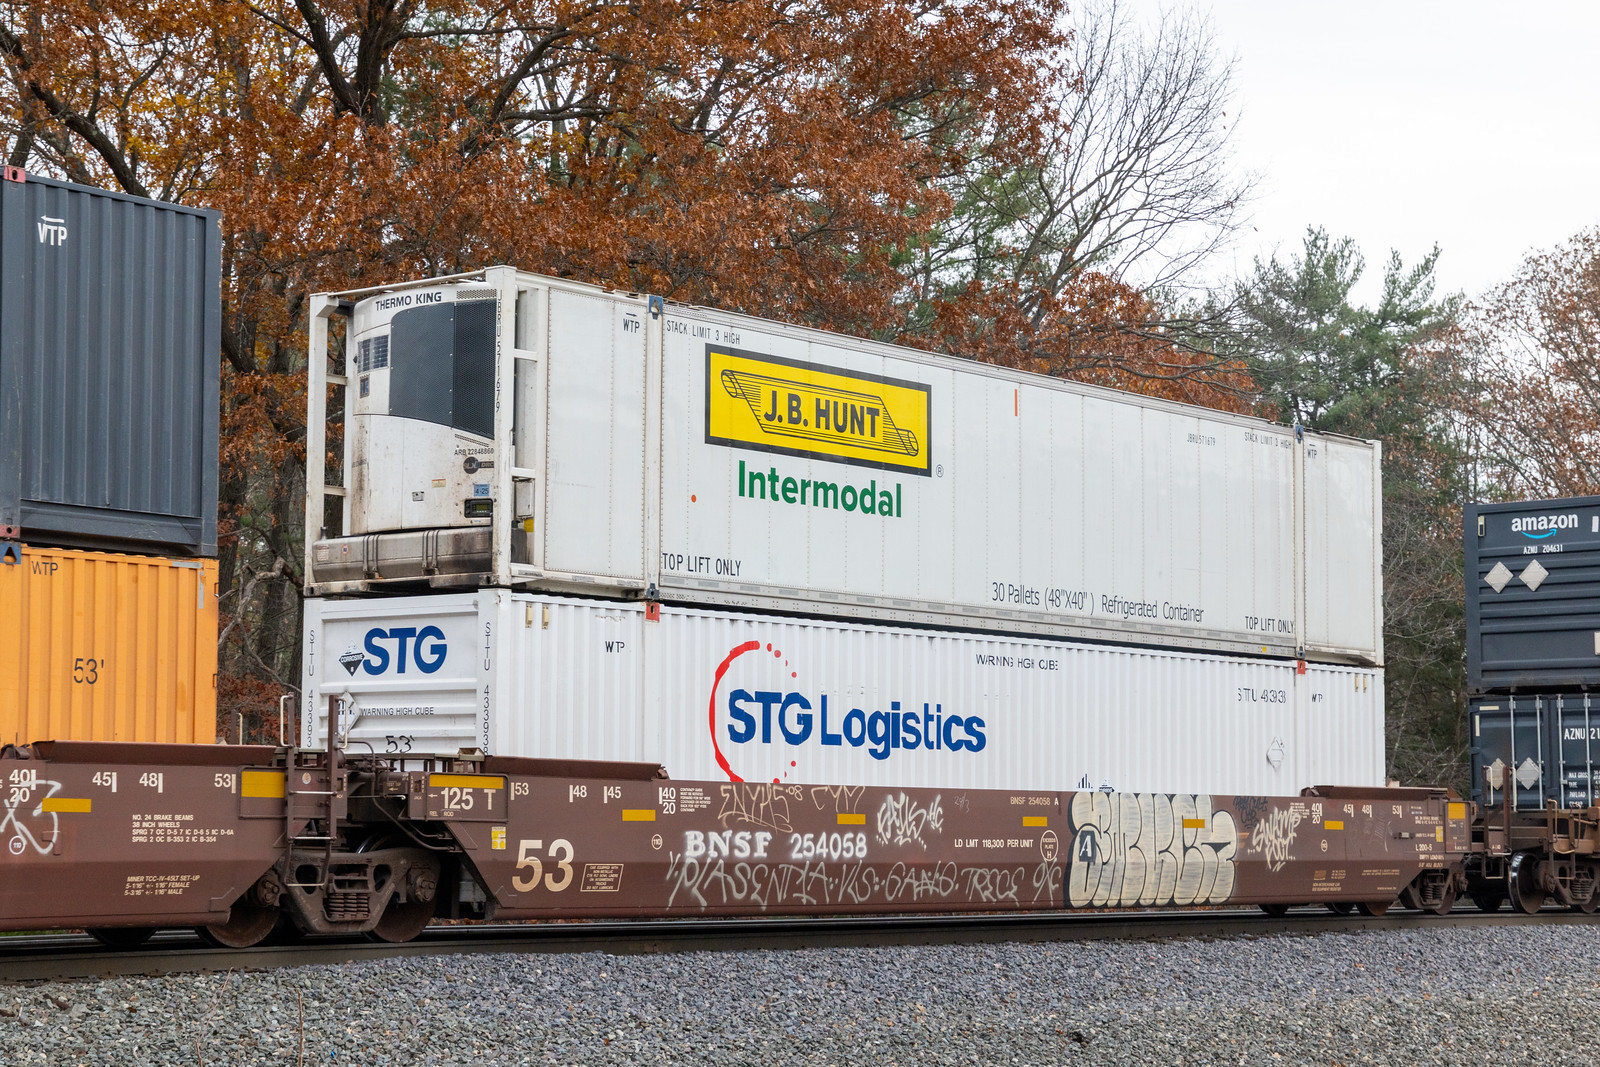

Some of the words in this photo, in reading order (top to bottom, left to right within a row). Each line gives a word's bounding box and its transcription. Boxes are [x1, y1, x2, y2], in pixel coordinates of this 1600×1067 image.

[376, 295, 412, 312] THERMO
[415, 291, 442, 303] KING
[623, 318, 640, 334] WTP
[666, 319, 688, 335] STACK
[692, 324, 711, 340] LIMIT
[715, 329, 720, 341] 3
[723, 332, 741, 345] HIGH
[763, 389, 809, 427] J.B.
[814, 396, 881, 438] HUNT
[1244, 431, 1259, 444] STACK
[1261, 434, 1273, 446] LIMIT
[1281, 439, 1292, 449] HIGH
[1307, 448, 1318, 459] WTP
[738, 459, 902, 518] Intermodal
[1511, 513, 1578, 532] amazon
[1523, 545, 1538, 555] AZNU
[1542, 544, 1563, 553] 204631
[31, 560, 59, 577] WTP
[662, 552, 684, 571] TOP
[687, 555, 711, 574] LIFT
[715, 558, 742, 577] ONLY
[991, 581, 1005, 602] 30
[1008, 583, 1040, 606] Pallets
[1101, 594, 1158, 620] Refrigerated
[1162, 601, 1205, 623] Container
[1244, 616, 1259, 630] TOP
[1260, 617, 1276, 632] LIFT
[1277, 619, 1295, 634] ONLY
[362, 625, 448, 676] STG
[605, 640, 625, 653] WTP
[73, 658, 105, 685] 53'
[361, 707, 394, 716] WARNING
[396, 707, 412, 716] HIGH
[415, 706, 435, 715] CUBE
[727, 688, 813, 746] STG
[821, 694, 987, 760] Logistics
[1564, 727, 1586, 740] AZNU
[9, 769, 31, 784] 40
[92, 771, 112, 787] 45
[139, 772, 158, 787] 48
[214, 773, 232, 788] 53
[1577, 771, 1588, 779] GROS
[10, 787, 30, 803] 20
[514, 782, 529, 796] 53
[573, 785, 587, 798] 48
[607, 786, 622, 799] 45
[662, 787, 676, 799] 40
[440, 787, 474, 811] 125
[483, 788, 497, 811] T
[1009, 796, 1026, 805] BNSF
[1028, 797, 1051, 806] 254058
[1054, 797, 1059, 806] A
[662, 802, 676, 814] 20
[1311, 802, 1320, 812] 40
[1343, 804, 1351, 813] 45
[1361, 804, 1370, 814] 48
[1392, 805, 1400, 814] 53
[1312, 814, 1321, 824] 20
[684, 829, 773, 859] BNSF
[789, 831, 868, 860] 254058
[954, 839, 963, 848] LD
[965, 839, 979, 848] LMT
[982, 839, 1004, 849] 118,300
[1007, 839, 1019, 848] PER
[1020, 839, 1034, 848] UNIT
[511, 838, 575, 893] 53
